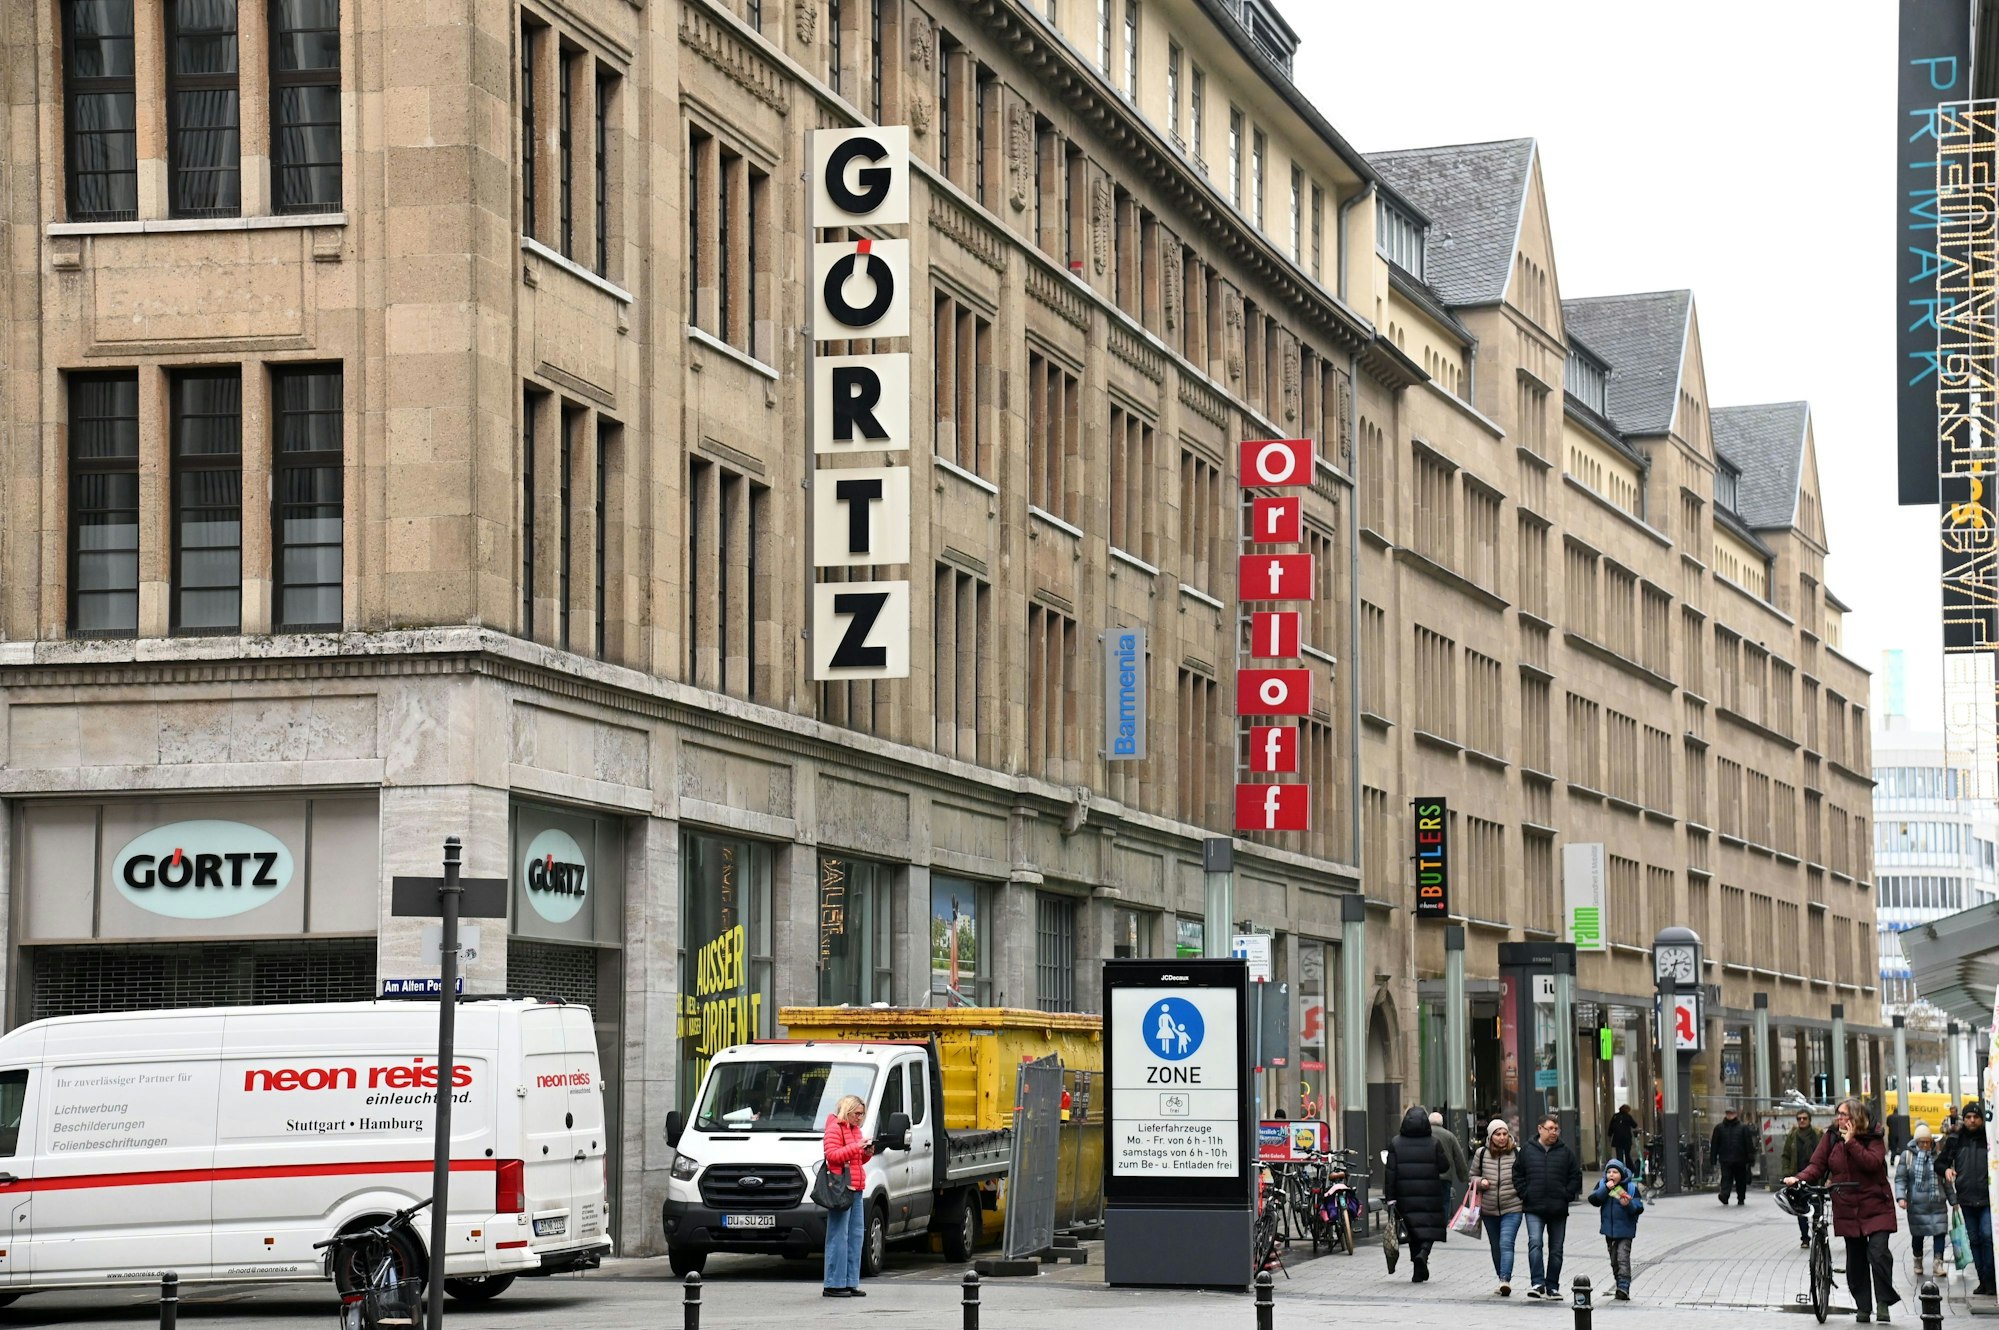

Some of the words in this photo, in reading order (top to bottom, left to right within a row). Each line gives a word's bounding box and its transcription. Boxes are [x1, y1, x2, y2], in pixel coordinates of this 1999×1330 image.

[1908, 55, 1957, 388] PRIMARK
[1114, 634, 1136, 755] Barmenia
[1419, 804, 1443, 898] BUTLERS
[696, 924, 745, 997] AUSSER
[385, 981, 399, 992] Am
[402, 980, 424, 992] Alten
[427, 979, 460, 992] Posf
[56, 1078, 71, 1088] Ihr
[74, 1075, 136, 1088] zuverlässiger
[138, 1073, 175, 1084] Partner
[177, 1072, 193, 1083] für
[244, 1068, 358, 1092] neon
[368, 1057, 473, 1089] reiss
[536, 1073, 568, 1089] neon
[568, 1069, 591, 1086] reiss
[1146, 1066, 1202, 1084] ZONE
[366, 1091, 473, 1105] einleuchtnd.
[54, 1103, 129, 1115] Lichtwerbung
[53, 1120, 145, 1133] Beschilderungen
[286, 1118, 346, 1134] Stuttgart
[359, 1118, 423, 1132] Hamburg
[1138, 1123, 1212, 1135] Lieferfahrzeuge
[52, 1137, 168, 1151] Folienbeschriftungen
[1127, 1136, 1143, 1145] Mo.
[1153, 1136, 1165, 1145] Fr.
[1168, 1137, 1184, 1145] von
[1122, 1148, 1168, 1159] samstags
[1170, 1149, 1187, 1157] von
[1118, 1161, 1139, 1169] zum
[1162, 1161, 1171, 1169] u.
[1173, 1160, 1214, 1169] Entladen
[1217, 1160, 1233, 1170] frei
[758, 1216, 774, 1225] 201
[106, 1270, 165, 1279] www.neonreiss.de
